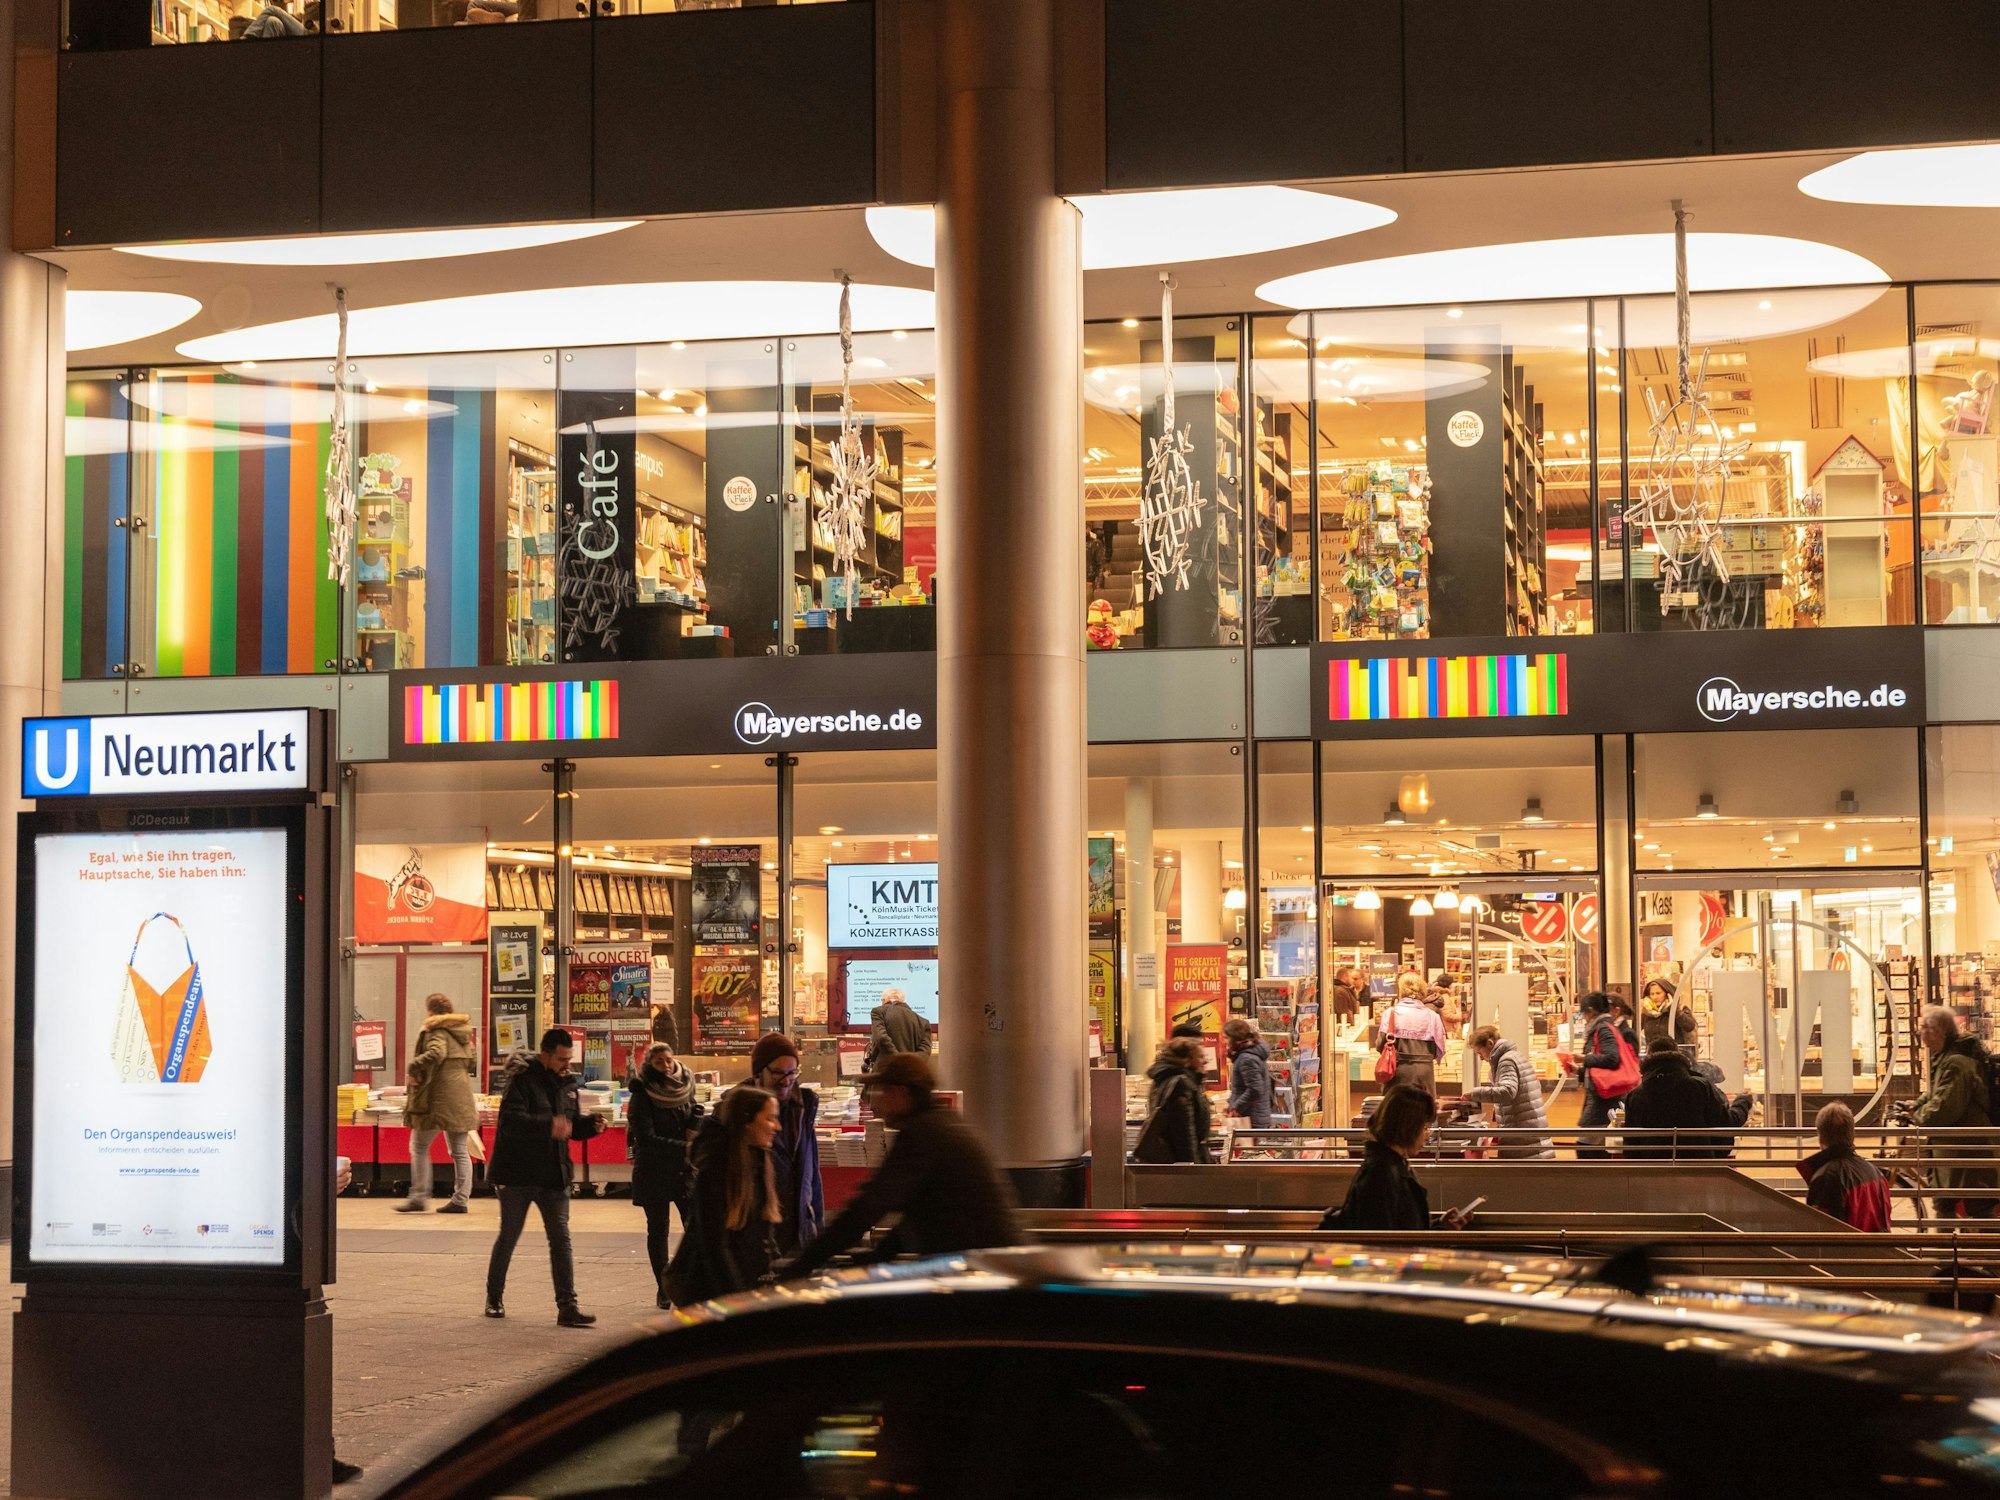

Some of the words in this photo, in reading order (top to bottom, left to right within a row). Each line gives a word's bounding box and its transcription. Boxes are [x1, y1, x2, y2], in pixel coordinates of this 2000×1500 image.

[1451, 420, 1479, 430] Kaffee
[727, 486, 752, 495] Kaffee
[578, 449, 619, 560] Café
[1706, 683, 1906, 715] Mayersche.de
[743, 708, 922, 738] Mayersche.de
[35, 728, 79, 790] U
[104, 729, 296, 777] Neumarkt
[130, 813, 190, 826] JCDecaux
[89, 852, 119, 865] Egal,
[122, 853, 144, 862] wie
[146, 851, 165, 862] Sie
[168, 850, 189, 862] ihn
[192, 850, 236, 864] tragen,
[79, 869, 154, 882] Hauptsache,
[158, 867, 176, 878] Sie
[179, 866, 218, 878] haben
[221, 866, 247, 878] ihn:
[872, 880, 938, 904] KMT
[871, 905, 914, 914] KölnMusik
[510, 931, 529, 939] LIVE
[588, 950, 650, 964] CONCERT
[1173, 958, 1187, 966] THE
[1189, 957, 1222, 966] GREATEST
[611, 965, 647, 983] Sinatra
[701, 965, 729, 973] JAGD
[730, 965, 751, 973] AUF
[1173, 967, 1222, 981] MUSICAL
[701, 973, 751, 996] 007
[1173, 981, 1184, 992] OF
[1186, 981, 1200, 992] ALL
[1202, 981, 1222, 992] TIME
[573, 992, 609, 1003] AFRIKA!
[509, 1003, 528, 1011] LIVE
[573, 1003, 609, 1013] AFRIKA!
[613, 1034, 650, 1042] WAHNSINN!
[84, 1128, 107, 1140] Den
[110, 1128, 237, 1142] Organspendeausweis!
[98, 1146, 141, 1154] Informieren,
[143, 1146, 186, 1154] entscheiden,
[188, 1146, 221, 1154] ausfüllen.
[119, 1167, 200, 1175] www.organspende-info.de
